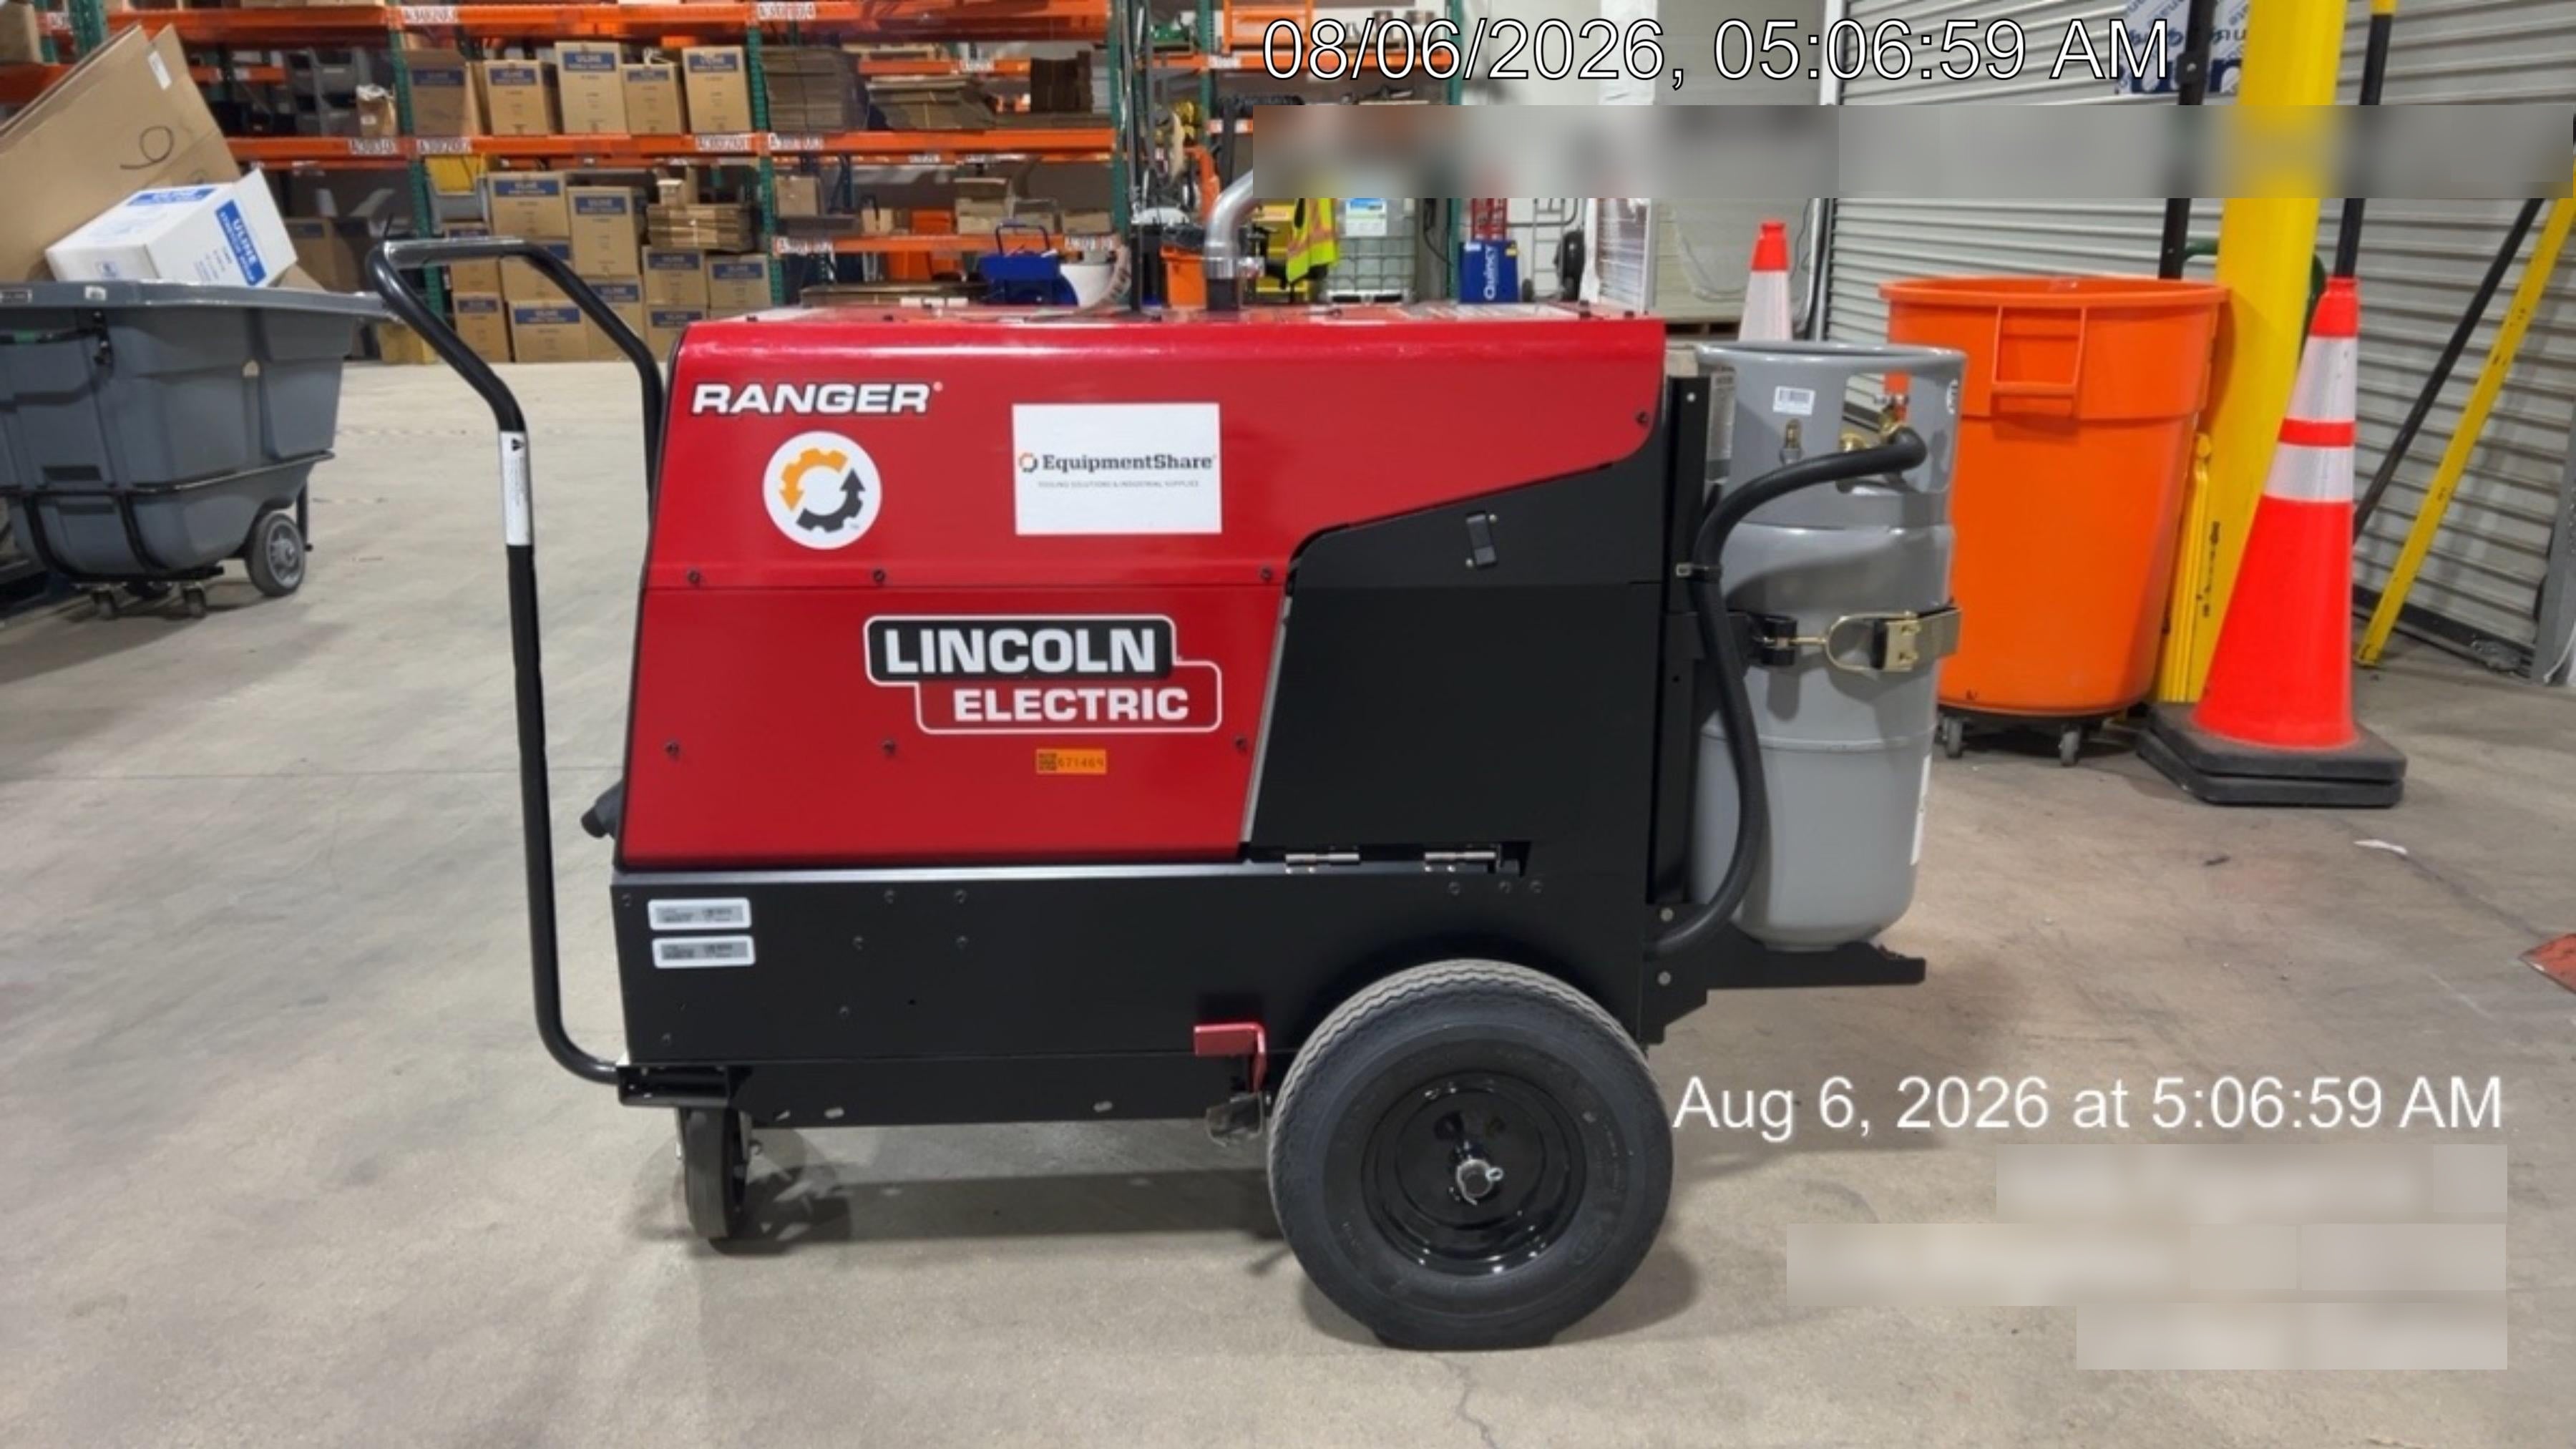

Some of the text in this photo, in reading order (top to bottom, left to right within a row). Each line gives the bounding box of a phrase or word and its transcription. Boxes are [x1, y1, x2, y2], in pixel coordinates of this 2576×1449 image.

[691, 383, 930, 414] RANGER
[1042, 454, 1213, 473] EquipmentShare
[884, 628, 1156, 674] LINCOLN
[953, 688, 1189, 722] ELECTRIC
